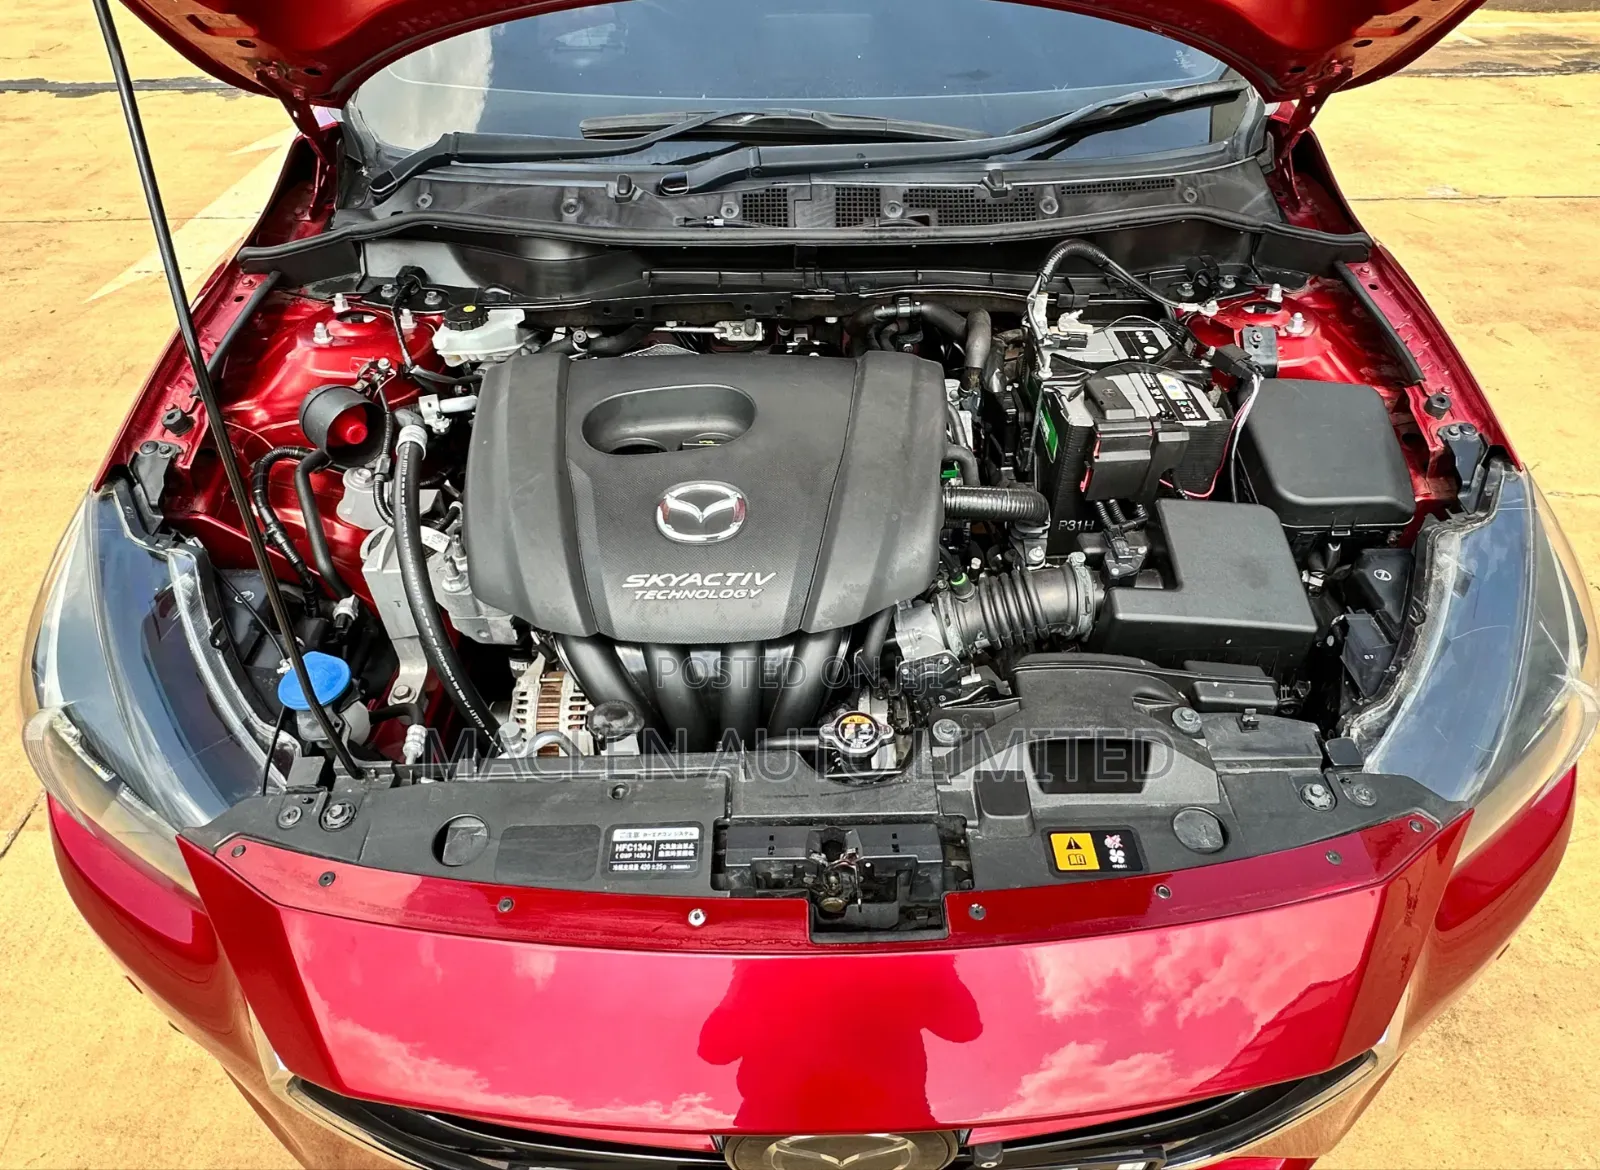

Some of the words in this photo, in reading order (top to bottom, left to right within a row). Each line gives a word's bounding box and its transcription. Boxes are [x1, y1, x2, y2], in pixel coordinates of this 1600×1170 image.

[1058, 520, 1095, 531] P31H
[622, 572, 777, 588] SKYACTIV
[634, 588, 764, 600] TECHNOLOGY
[615, 843, 653, 852] HFC134a
